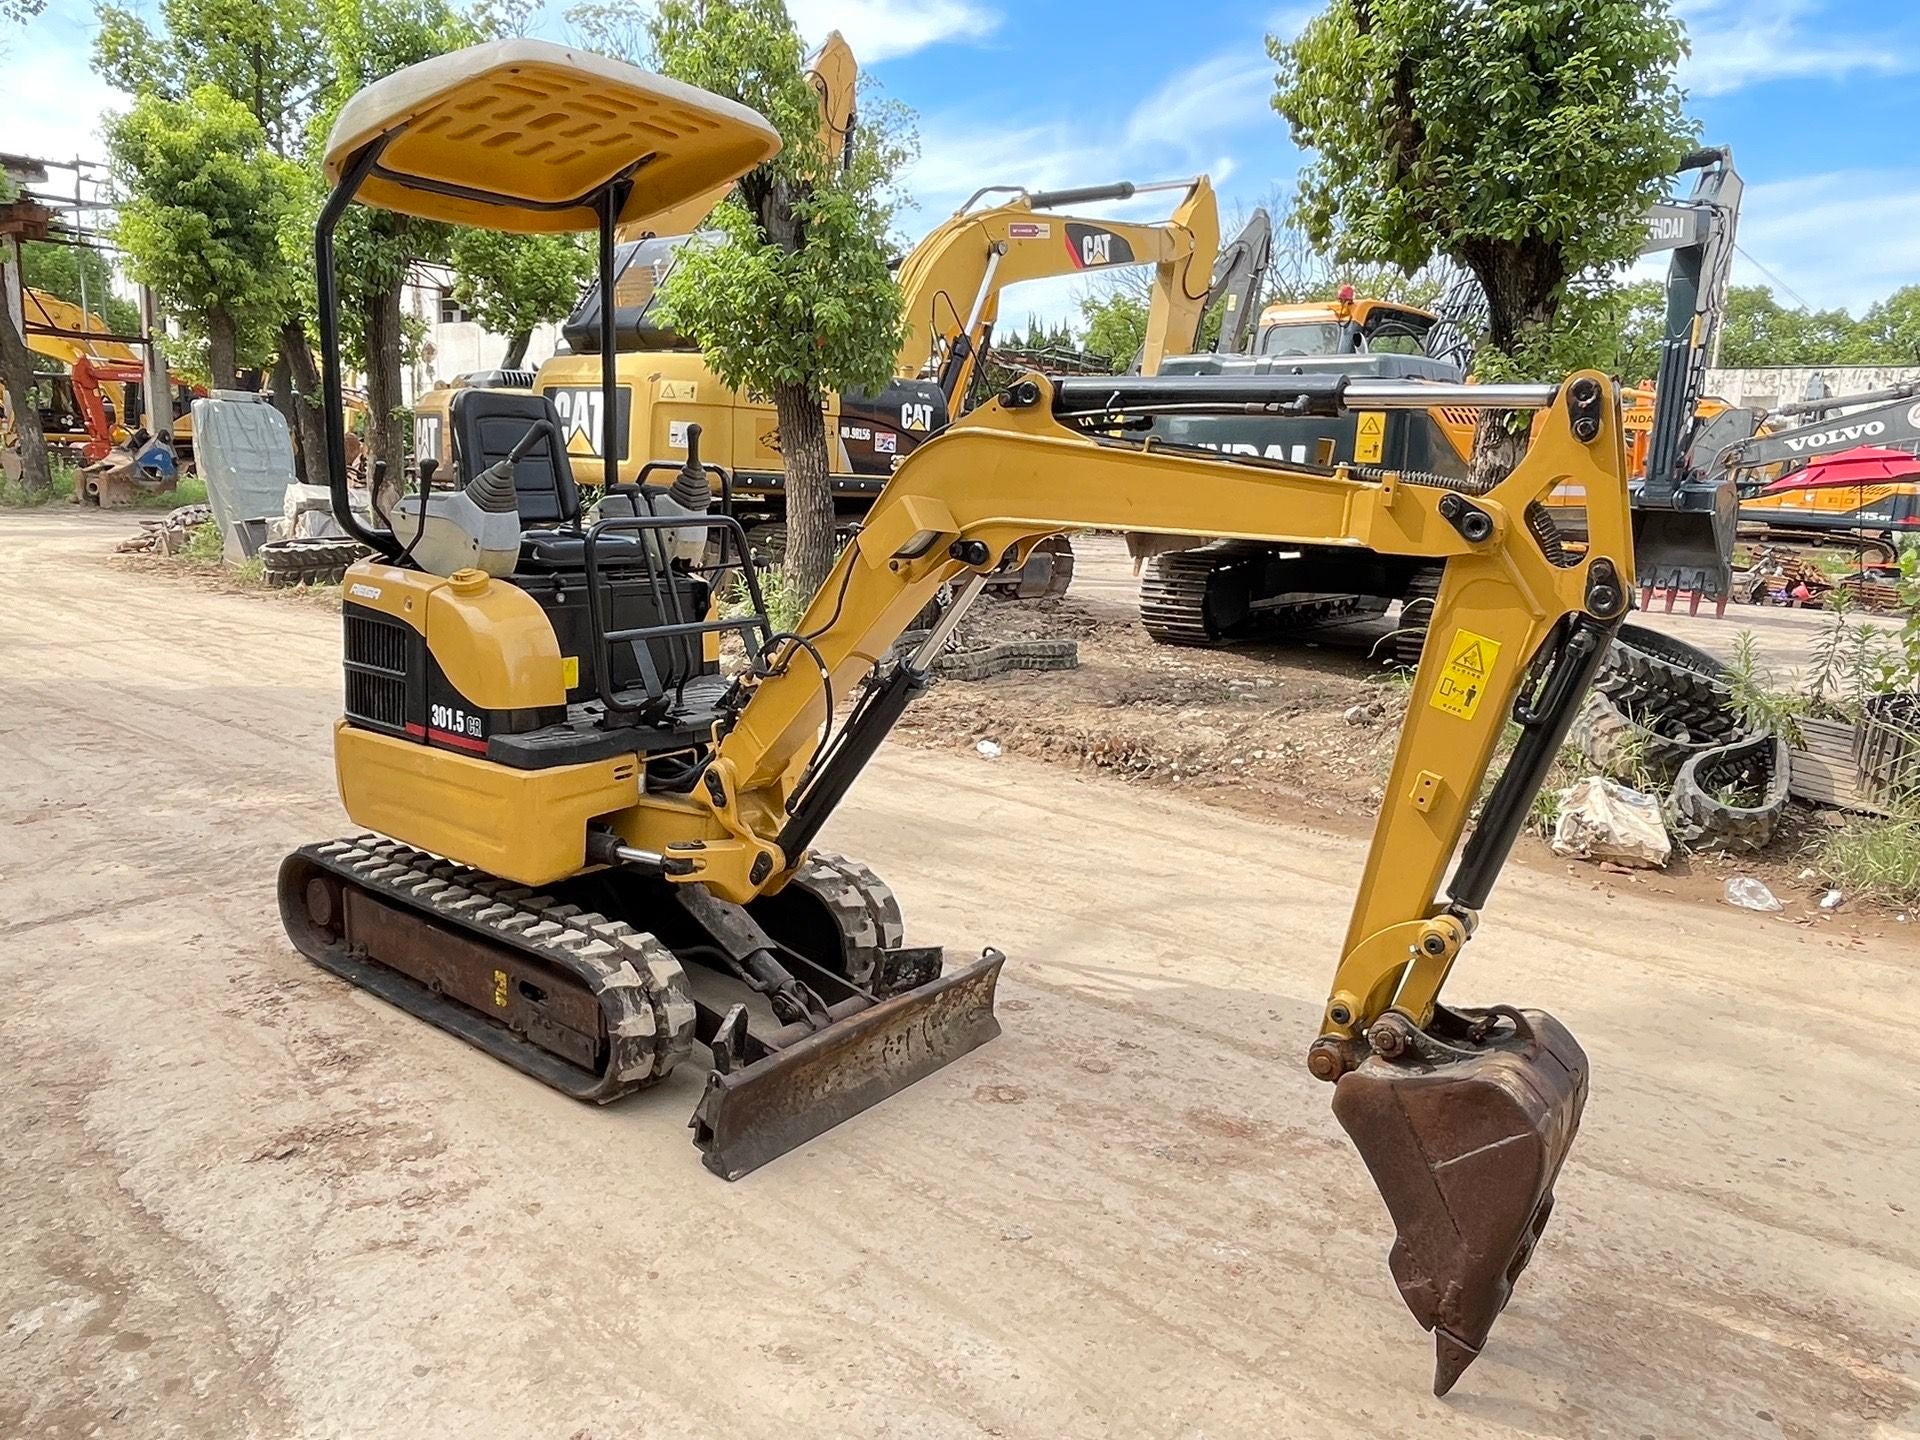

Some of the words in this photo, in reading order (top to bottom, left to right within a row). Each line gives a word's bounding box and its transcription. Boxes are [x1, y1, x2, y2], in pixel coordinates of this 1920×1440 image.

[1082, 233, 1111, 266] CAT
[555, 390, 604, 457] CAT
[901, 402, 934, 432] CAT
[416, 417, 439, 460] CAT
[1783, 420, 1886, 452] VOLVO
[431, 703, 465, 733] 301.5
[466, 715, 483, 738] CR
